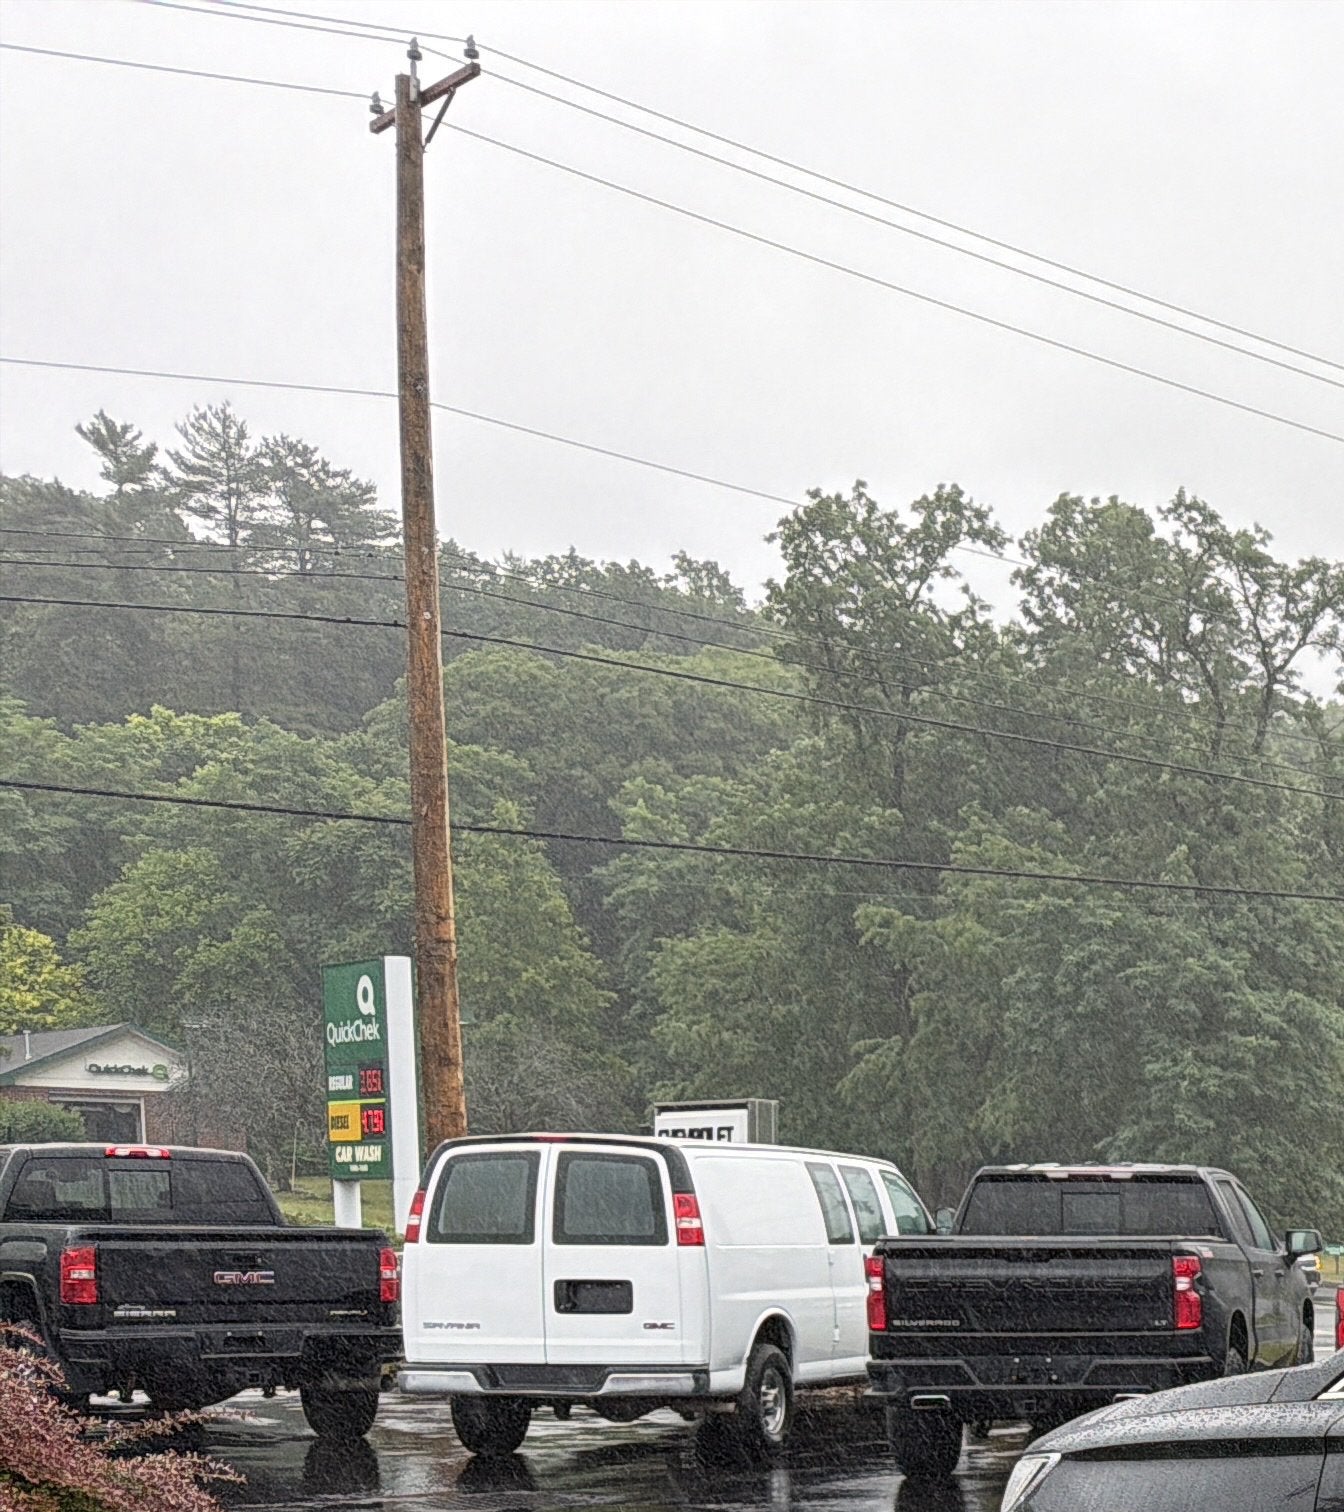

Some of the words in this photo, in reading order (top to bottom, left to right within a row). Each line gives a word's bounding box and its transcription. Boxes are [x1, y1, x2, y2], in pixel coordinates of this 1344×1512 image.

[356, 974, 376, 1015] Q
[326, 1017, 380, 1047] QuickChek
[335, 1145, 353, 1163] CAR
[355, 1144, 382, 1162] WASH
[213, 1270, 275, 1285] GMC
[643, 1322, 676, 1330] GMC
[892, 1318, 960, 1328] SILVERADO
